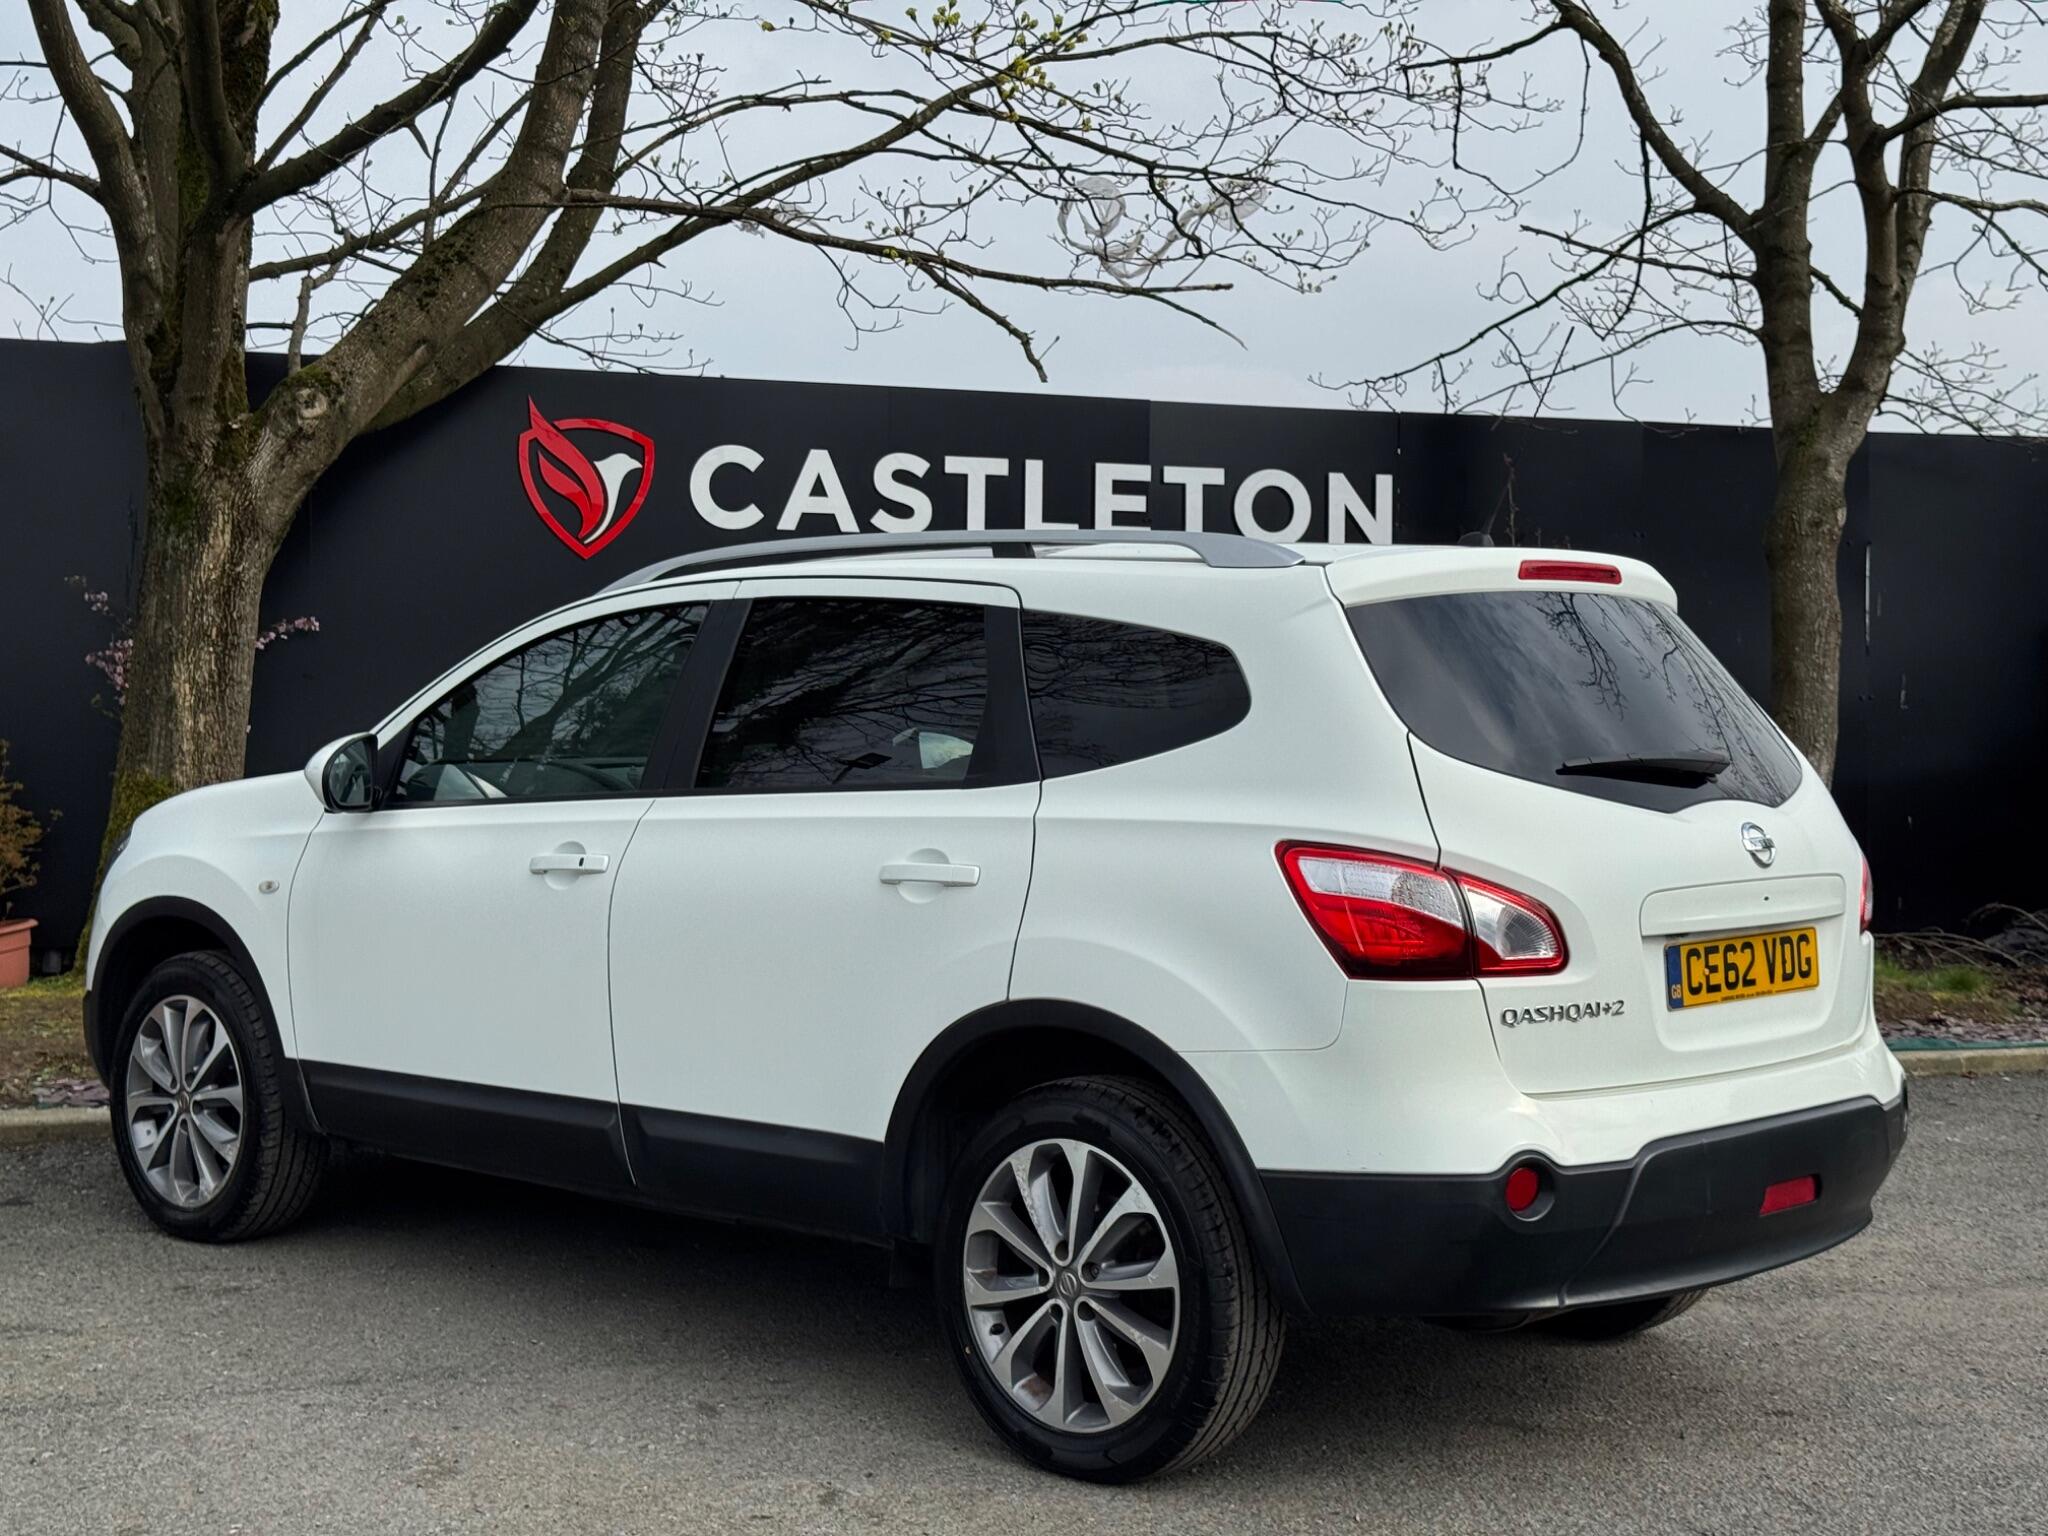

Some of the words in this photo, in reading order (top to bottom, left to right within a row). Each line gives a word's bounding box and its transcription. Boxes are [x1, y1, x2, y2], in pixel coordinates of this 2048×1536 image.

[689, 444, 1393, 545] CASTLETON
[1686, 941, 1757, 996] CE62
[1763, 933, 1812, 984] VDG
[1501, 1000, 1625, 1028] QASHQAI+2
[1671, 984, 1682, 999] GB
